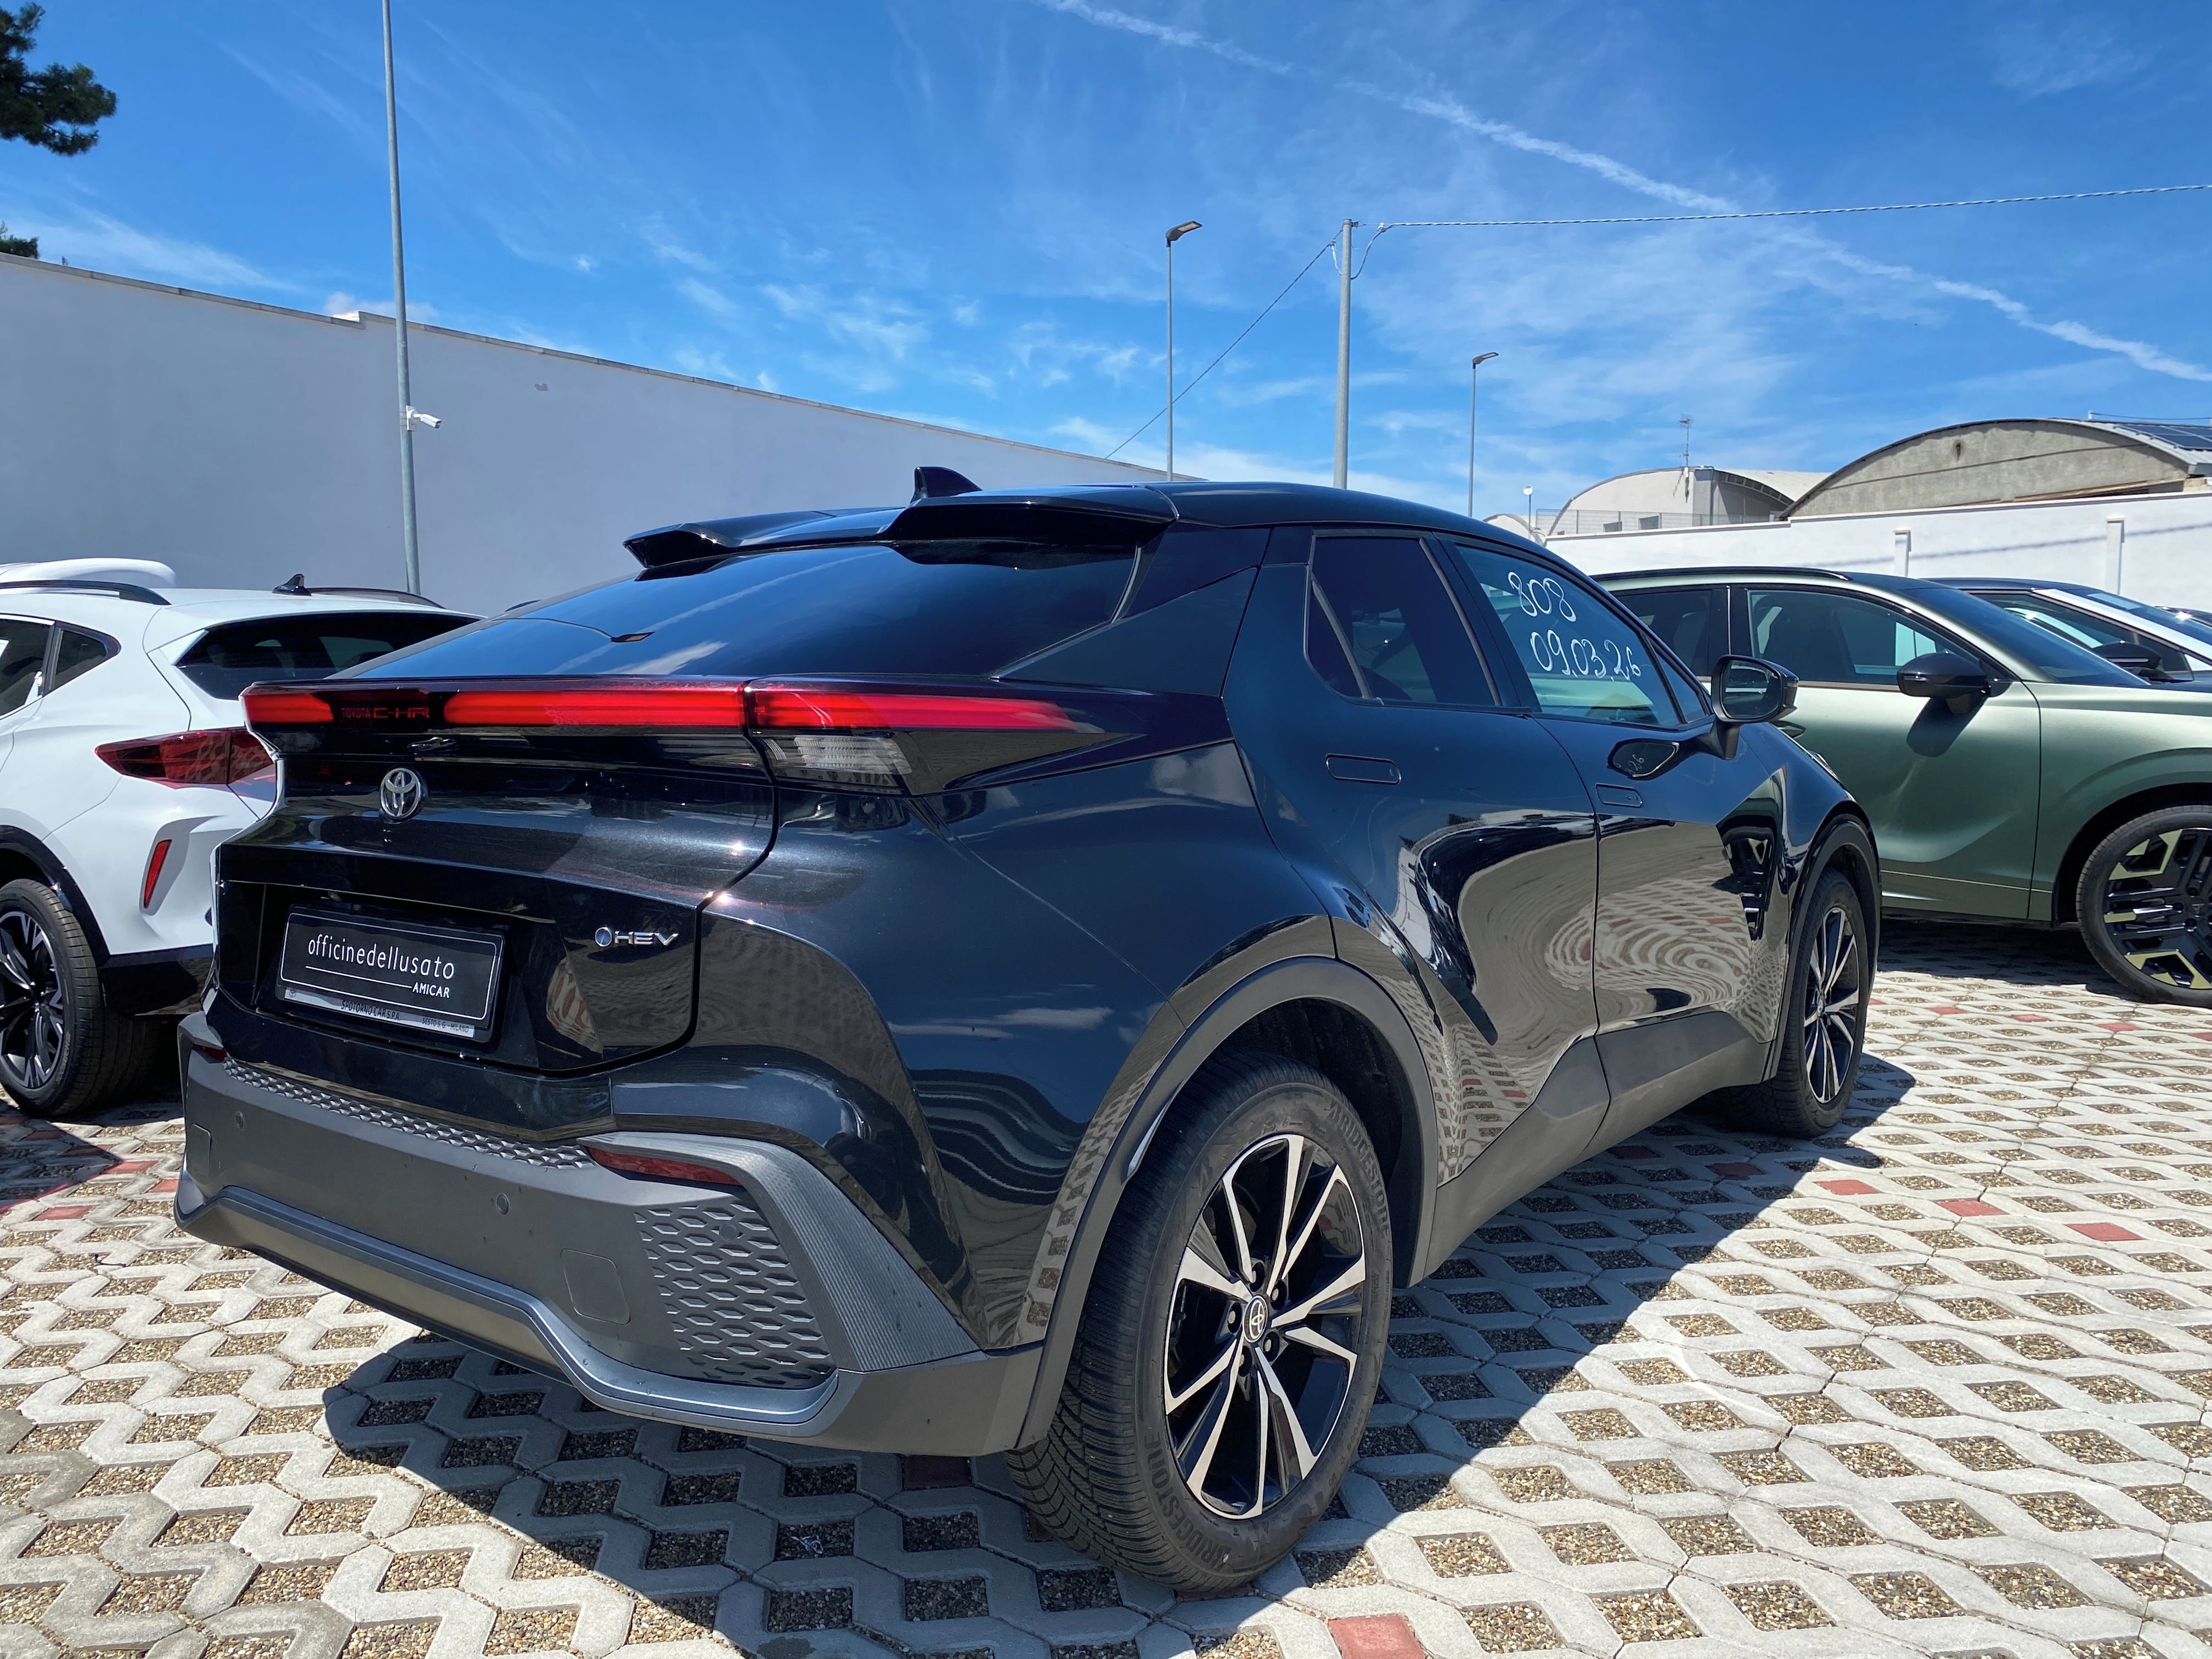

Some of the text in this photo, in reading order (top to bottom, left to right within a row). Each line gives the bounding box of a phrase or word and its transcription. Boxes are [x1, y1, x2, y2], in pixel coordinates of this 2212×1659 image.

[1508, 572, 1577, 623] 808
[341, 707, 431, 718] TOYOTA C-HR
[614, 931, 679, 946] HEV
[308, 933, 455, 980] officinedellusato
[412, 981, 450, 998] AMICAR
[341, 1000, 373, 1015] SPOTORNO
[374, 1007, 386, 1018] CAR
[421, 1017, 437, 1027] SESTO
[450, 1022, 469, 1033] MILANO
[1325, 1098, 1390, 1236] BRIDGESTONE
[1144, 1430, 1232, 1572] BRIDGESTONE
